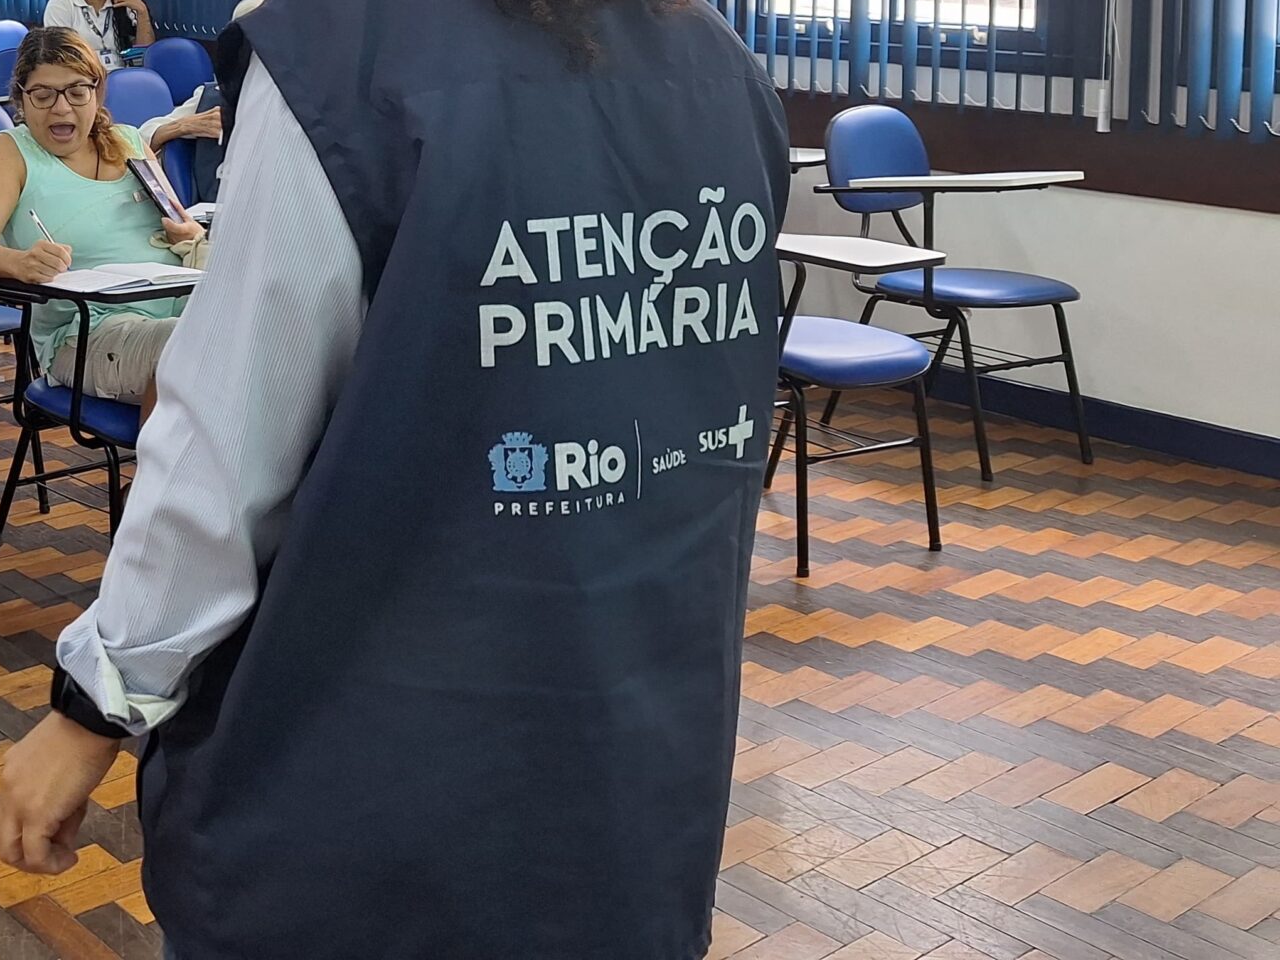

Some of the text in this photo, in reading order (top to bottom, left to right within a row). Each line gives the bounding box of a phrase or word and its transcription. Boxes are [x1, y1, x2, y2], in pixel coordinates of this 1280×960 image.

[479, 186, 767, 286] ATENÇÃO
[479, 277, 760, 368] PRIMÁRIA
[553, 438, 627, 492] Rio
[697, 427, 728, 453] SUS
[493, 491, 626, 517] PREFEITURA
